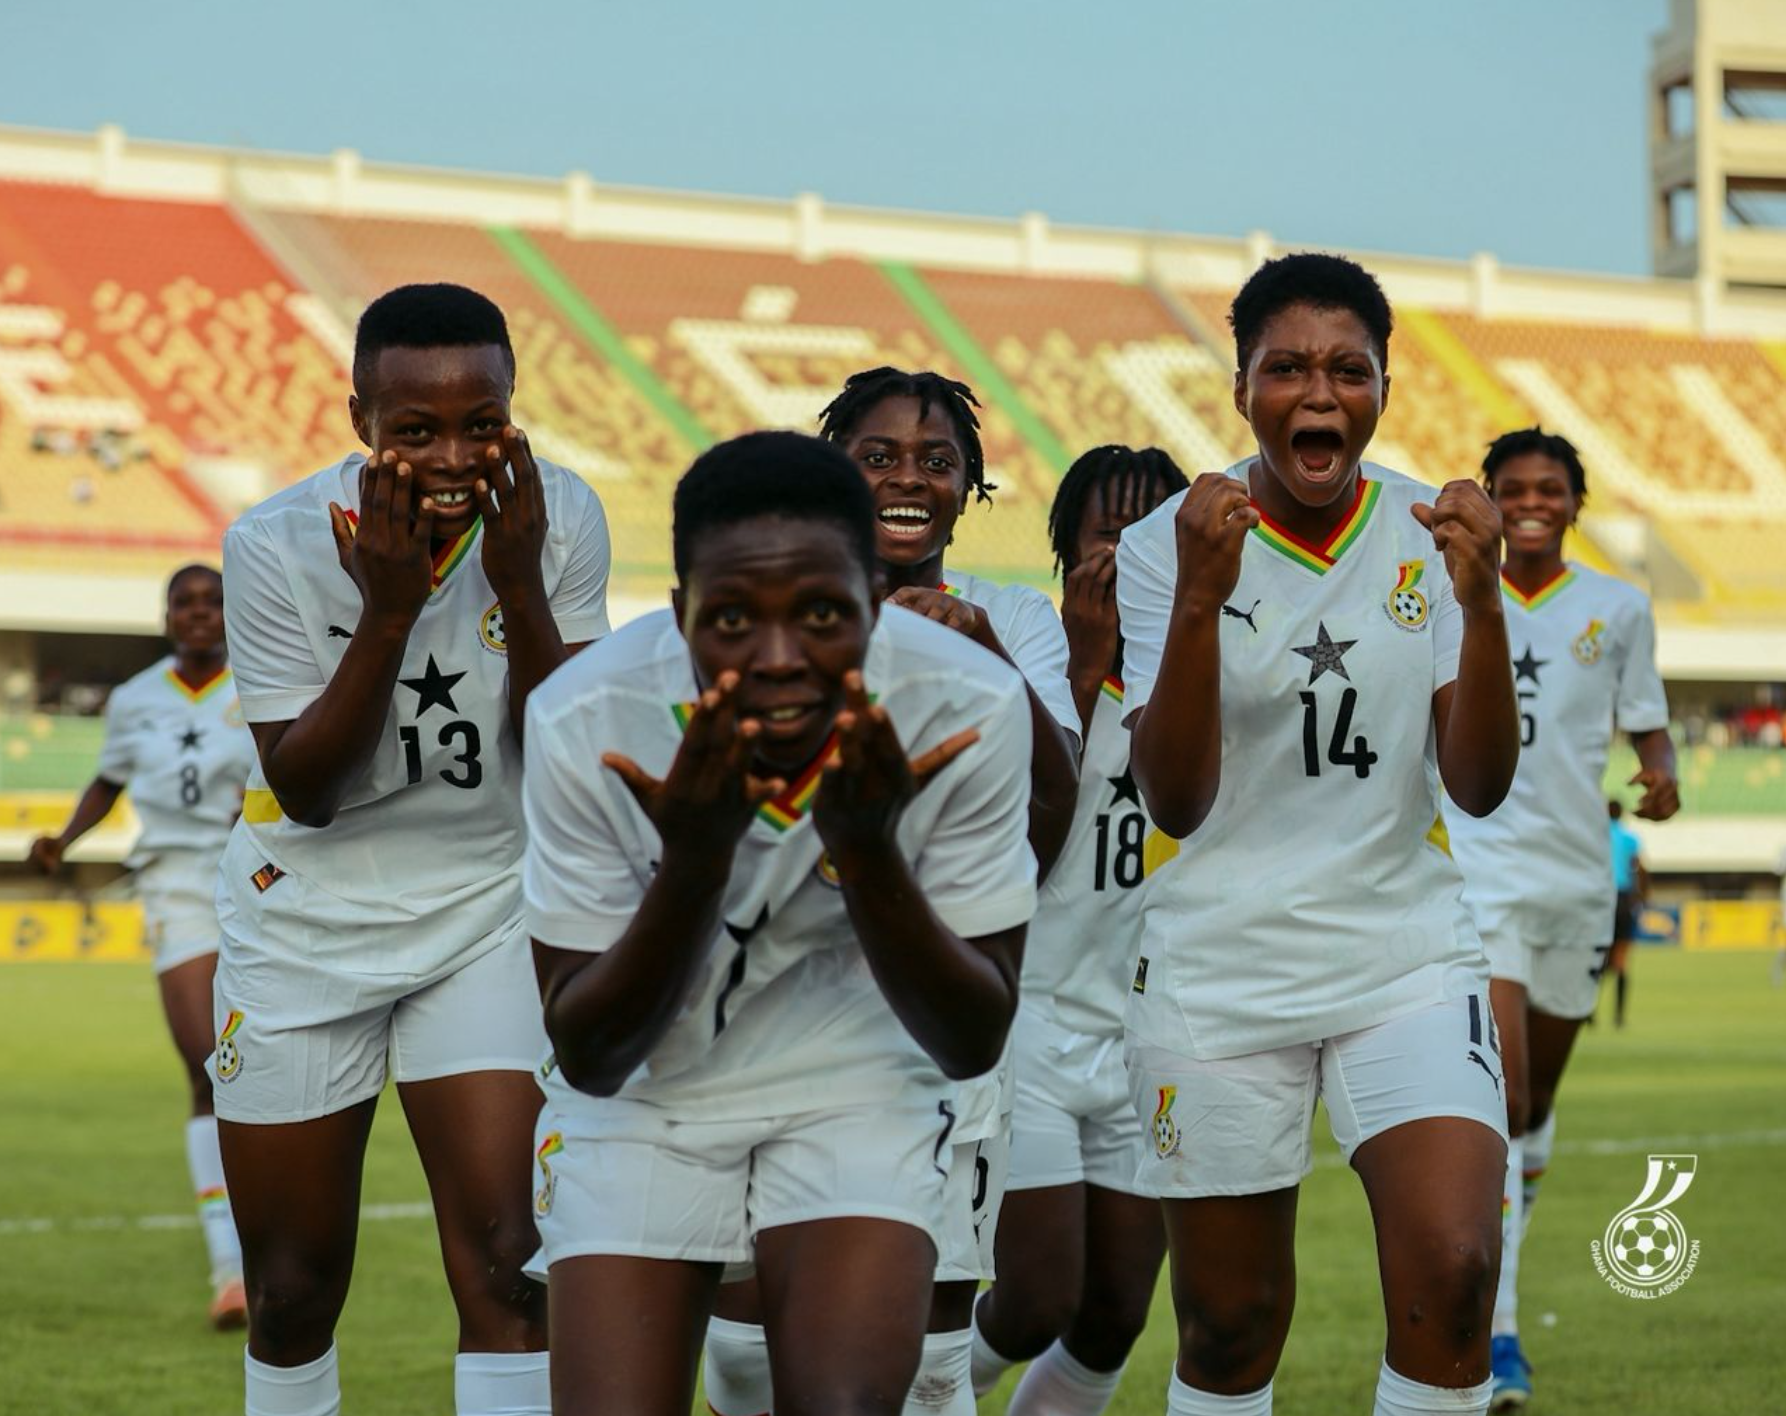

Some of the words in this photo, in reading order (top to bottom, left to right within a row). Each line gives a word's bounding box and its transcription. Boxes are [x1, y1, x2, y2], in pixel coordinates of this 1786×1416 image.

[399, 720, 482, 789] 13
[1298, 687, 1378, 779] 14
[179, 763, 202, 808] 8
[1094, 812, 1146, 891] 18
